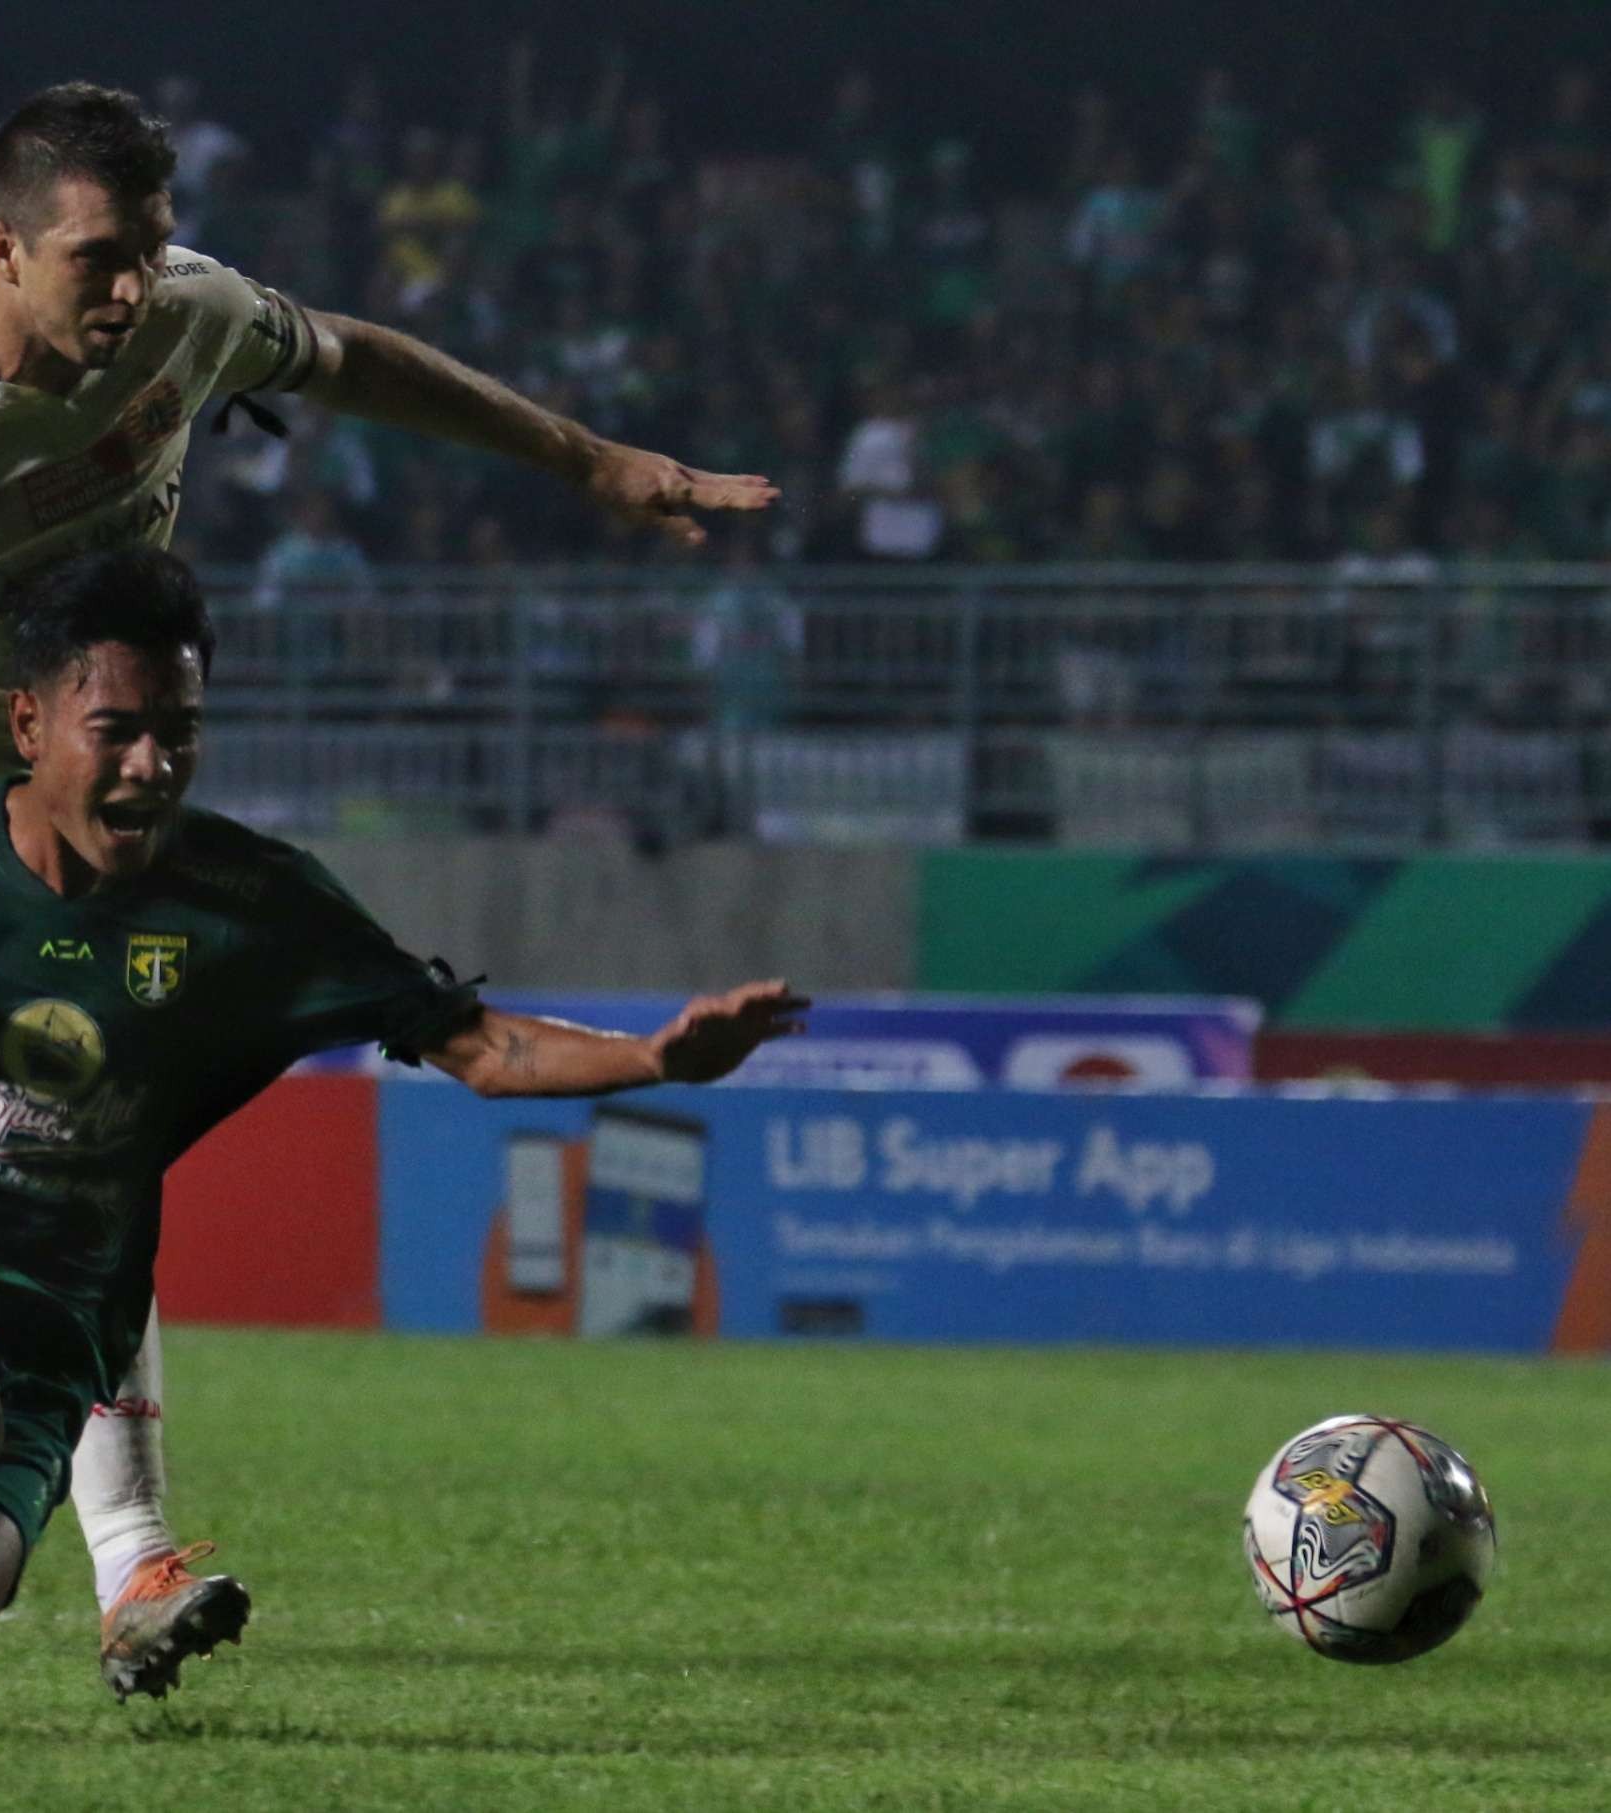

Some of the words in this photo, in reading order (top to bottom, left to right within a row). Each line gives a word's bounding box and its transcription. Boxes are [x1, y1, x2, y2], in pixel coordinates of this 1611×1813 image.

[163, 262, 210, 278] TORE
[771, 1119, 864, 1189] LIB
[882, 1120, 1059, 1209] Super
[1078, 1125, 1212, 1213] App
